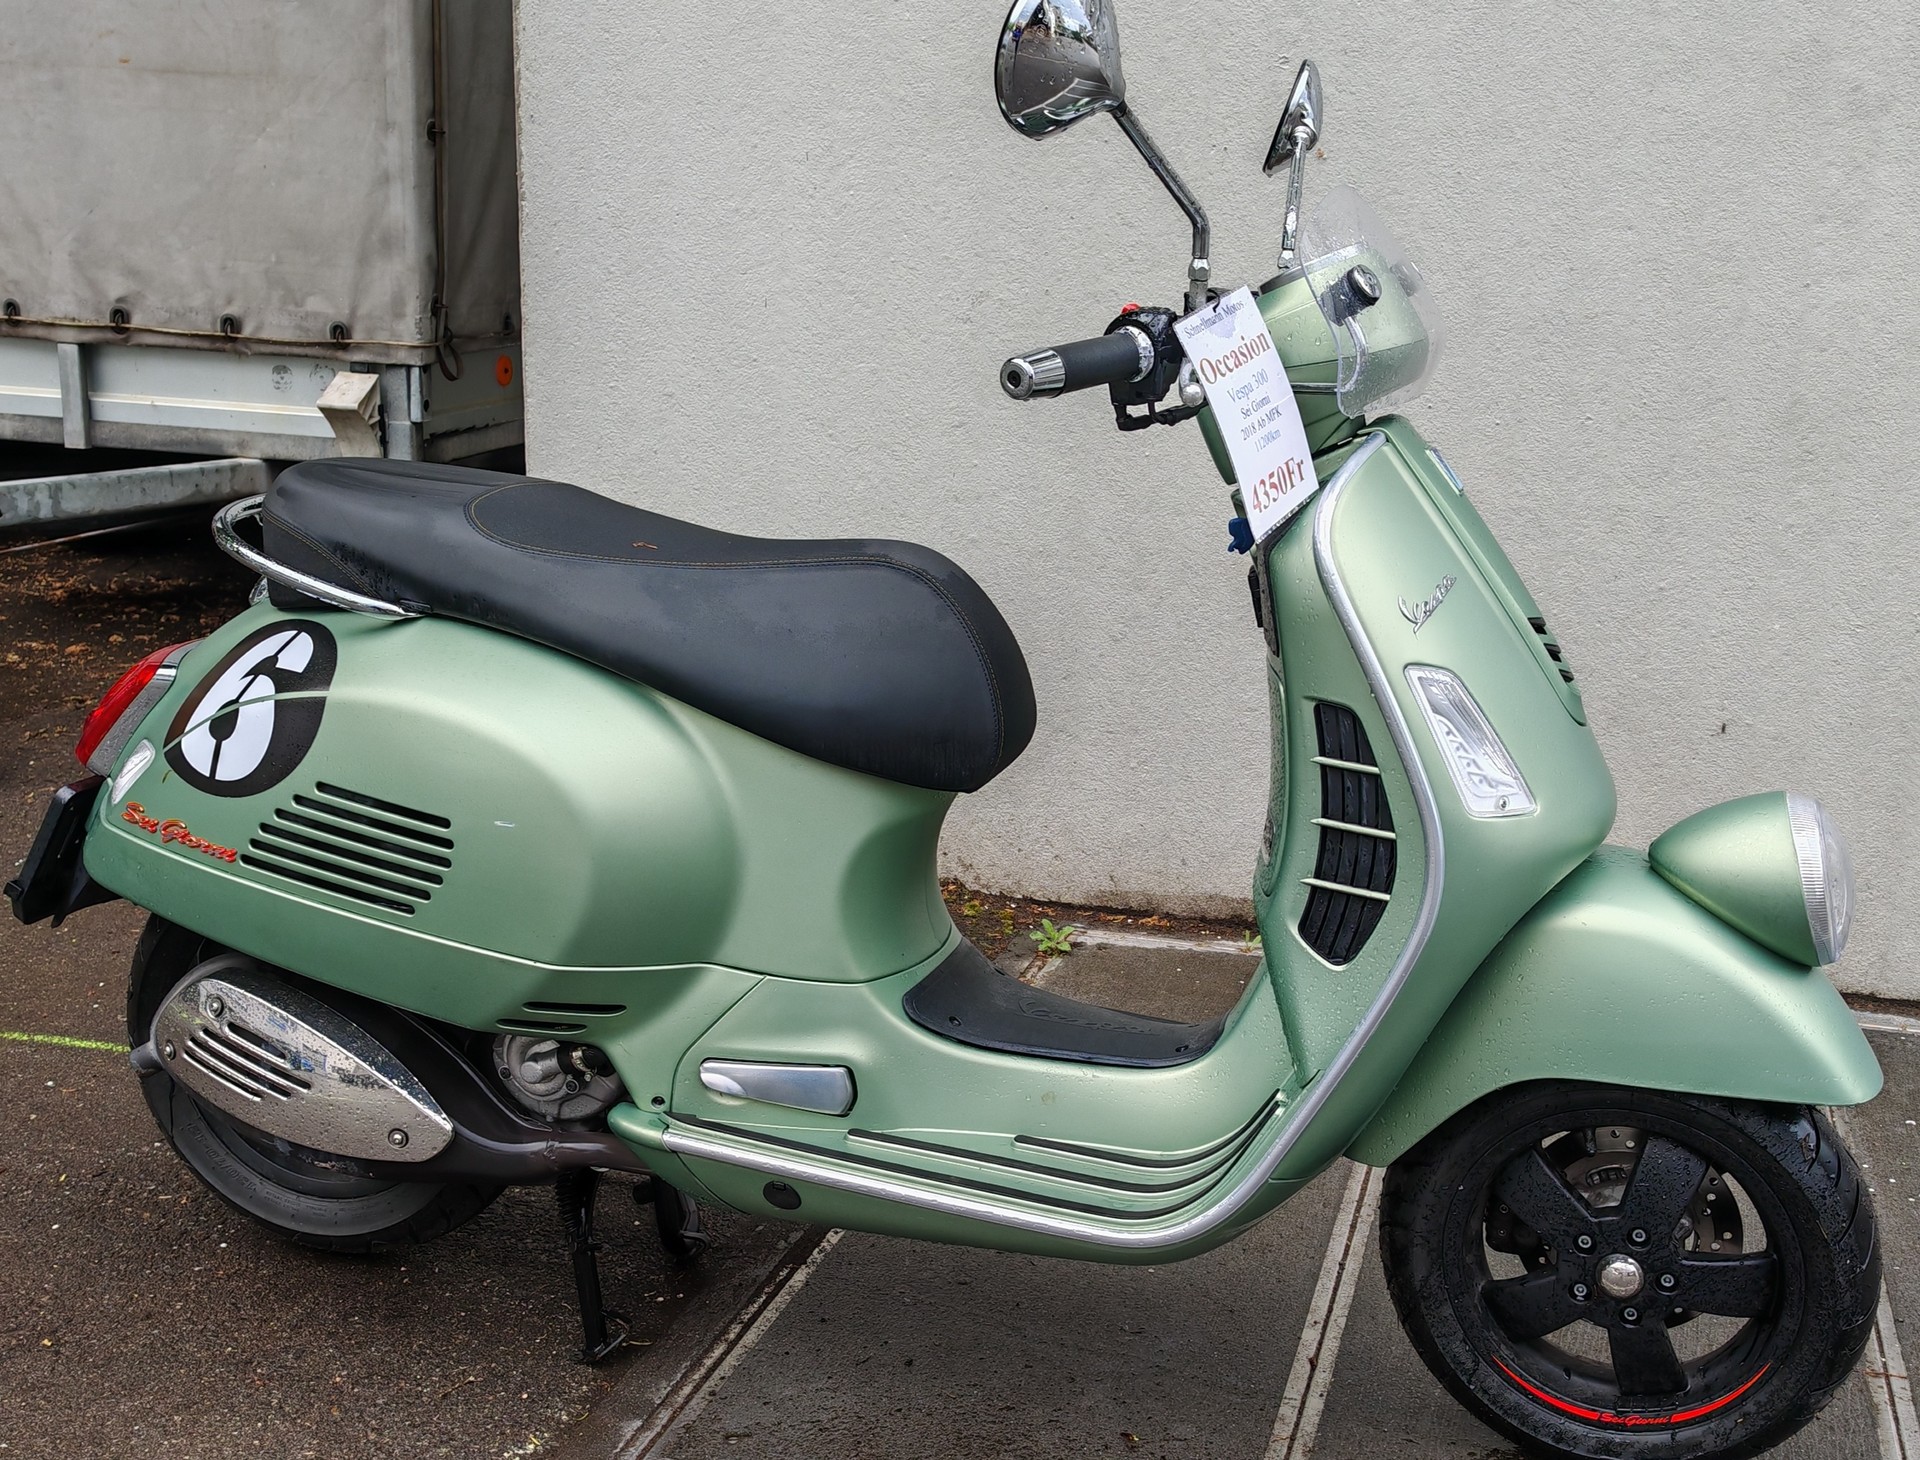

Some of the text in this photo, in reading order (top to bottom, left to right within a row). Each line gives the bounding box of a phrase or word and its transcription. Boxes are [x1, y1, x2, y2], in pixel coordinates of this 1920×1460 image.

[1184, 301, 1245, 339] Schnellmann Motos
[1199, 332, 1271, 385] Occasion
[1227, 368, 1269, 403] Vespa 300
[1240, 392, 1271, 420] Sei Giorni
[1241, 405, 1282, 441] 2018 Ab MFK
[1254, 429, 1281, 452] 11200km
[1253, 457, 1304, 513] 4350Fr
[1398, 574, 1457, 634] Vespa
[180, 630, 314, 781] 6
[1600, 1412, 1670, 1428] Sei Giorni
